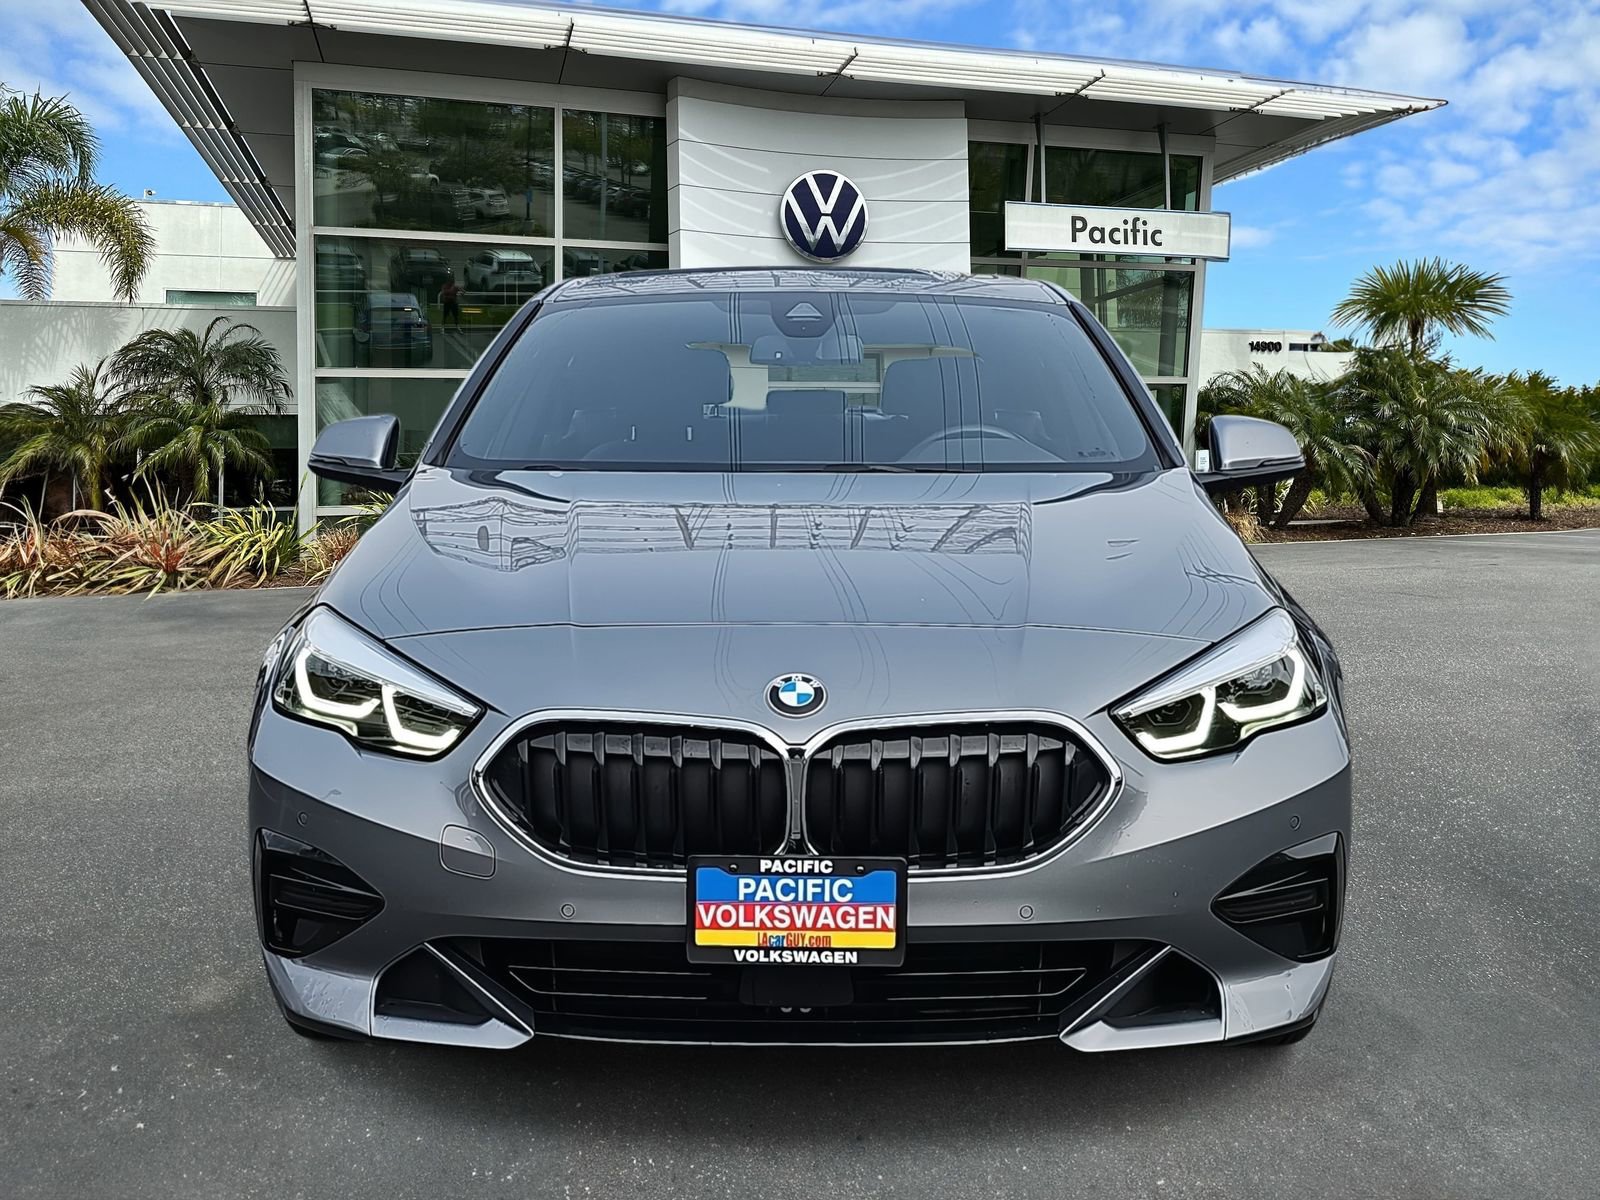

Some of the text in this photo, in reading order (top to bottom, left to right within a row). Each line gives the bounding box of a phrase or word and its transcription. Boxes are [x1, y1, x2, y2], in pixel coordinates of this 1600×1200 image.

[1071, 216, 1163, 246] Pacific
[1248, 341, 1282, 352] 14900
[759, 860, 833, 874] PACIFIC
[738, 878, 853, 902] PACIFIC
[698, 904, 894, 929] VOLKSWAGEN
[733, 950, 858, 964] VOLKSWAGEN
